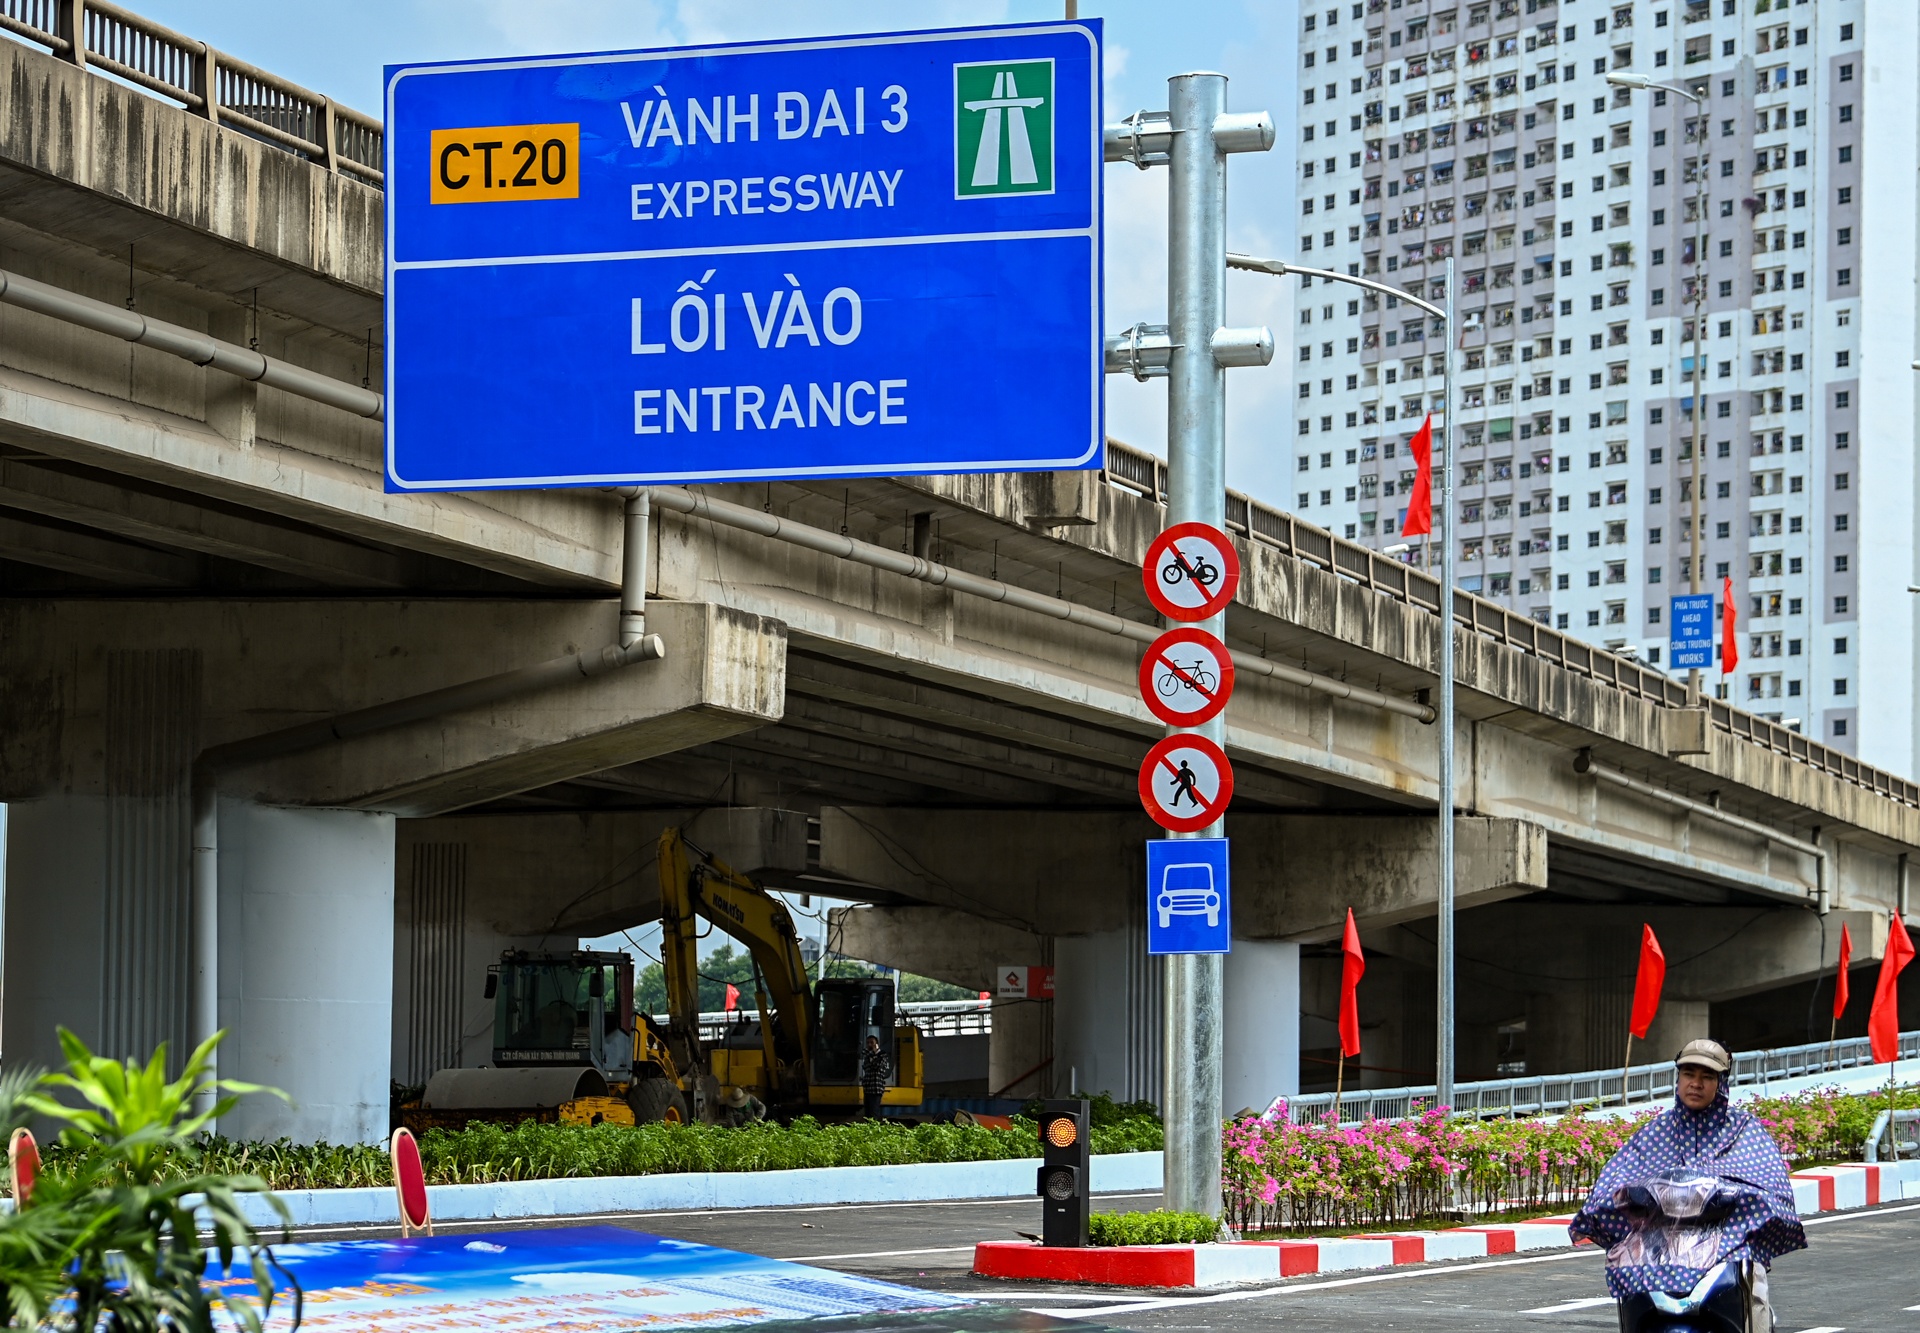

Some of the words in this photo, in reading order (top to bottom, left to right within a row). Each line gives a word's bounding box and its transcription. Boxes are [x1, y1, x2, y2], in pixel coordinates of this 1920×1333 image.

[620, 85, 759, 148] VÀNH
[774, 86, 865, 140] ĐAI
[881, 84, 908, 133] 3
[439, 138, 567, 190] CT.20
[631, 169, 904, 221] EXPRESSWAY
[631, 269, 726, 355] LỐI
[741, 273, 862, 349] VÀO
[634, 379, 908, 435] ENTRANCE
[1682, 613, 1701, 624] AHEAD
[1682, 627, 1693, 636] 100
[1678, 653, 1704, 665] WORKS
[713, 893, 744, 923] KOMATSU
